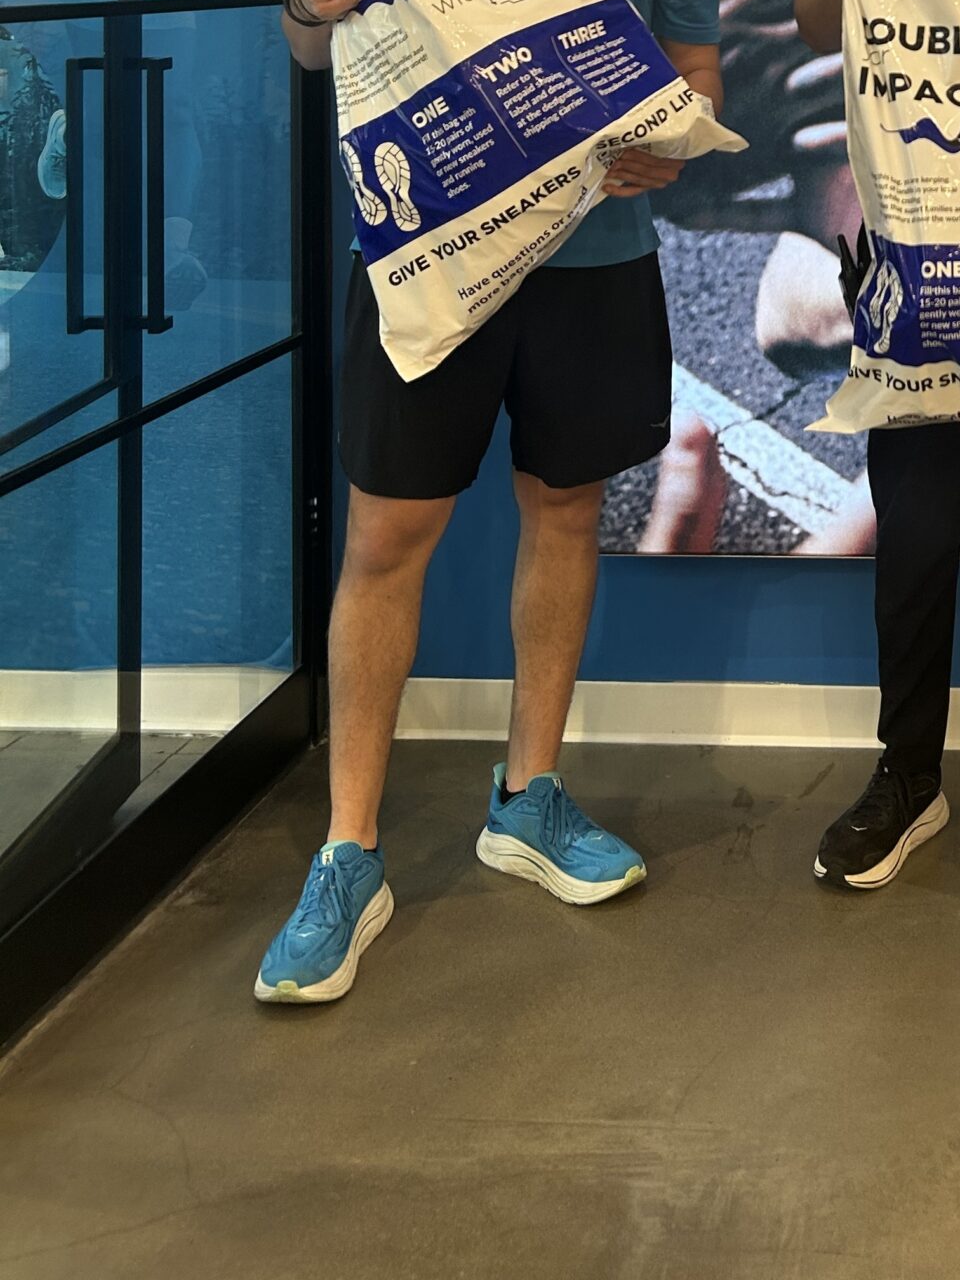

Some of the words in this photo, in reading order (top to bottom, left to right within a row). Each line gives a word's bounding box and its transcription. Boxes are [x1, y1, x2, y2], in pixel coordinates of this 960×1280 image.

[558, 20, 607, 50] THREE
[483, 47, 532, 82] TWO
[496, 79, 521, 98] Refer
[520, 73, 531, 83] to
[502, 84, 536, 109] prepaid
[409, 96, 450, 129] ONE
[508, 100, 532, 118] label
[530, 90, 548, 105] and
[443, 117, 460, 132] bag
[458, 106, 476, 121] with
[463, 121, 474, 132] of
[472, 124, 494, 141] used
[457, 138, 495, 164] sneakers
[389, 255, 430, 286] GIVE
[430, 231, 481, 260] YOUR
[480, 165, 581, 236] SNEAKERS
[596, 108, 668, 149] SECOND
[457, 277, 490, 300] Have
[491, 229, 551, 279] questions
[551, 218, 565, 231] or
[568, 186, 588, 218] nd
[468, 287, 500, 314] more
[920, 298, 946, 308] 15-20
[919, 309, 947, 320] gently
[931, 321, 950, 329] new
[885, 371, 933, 392] YOUR
